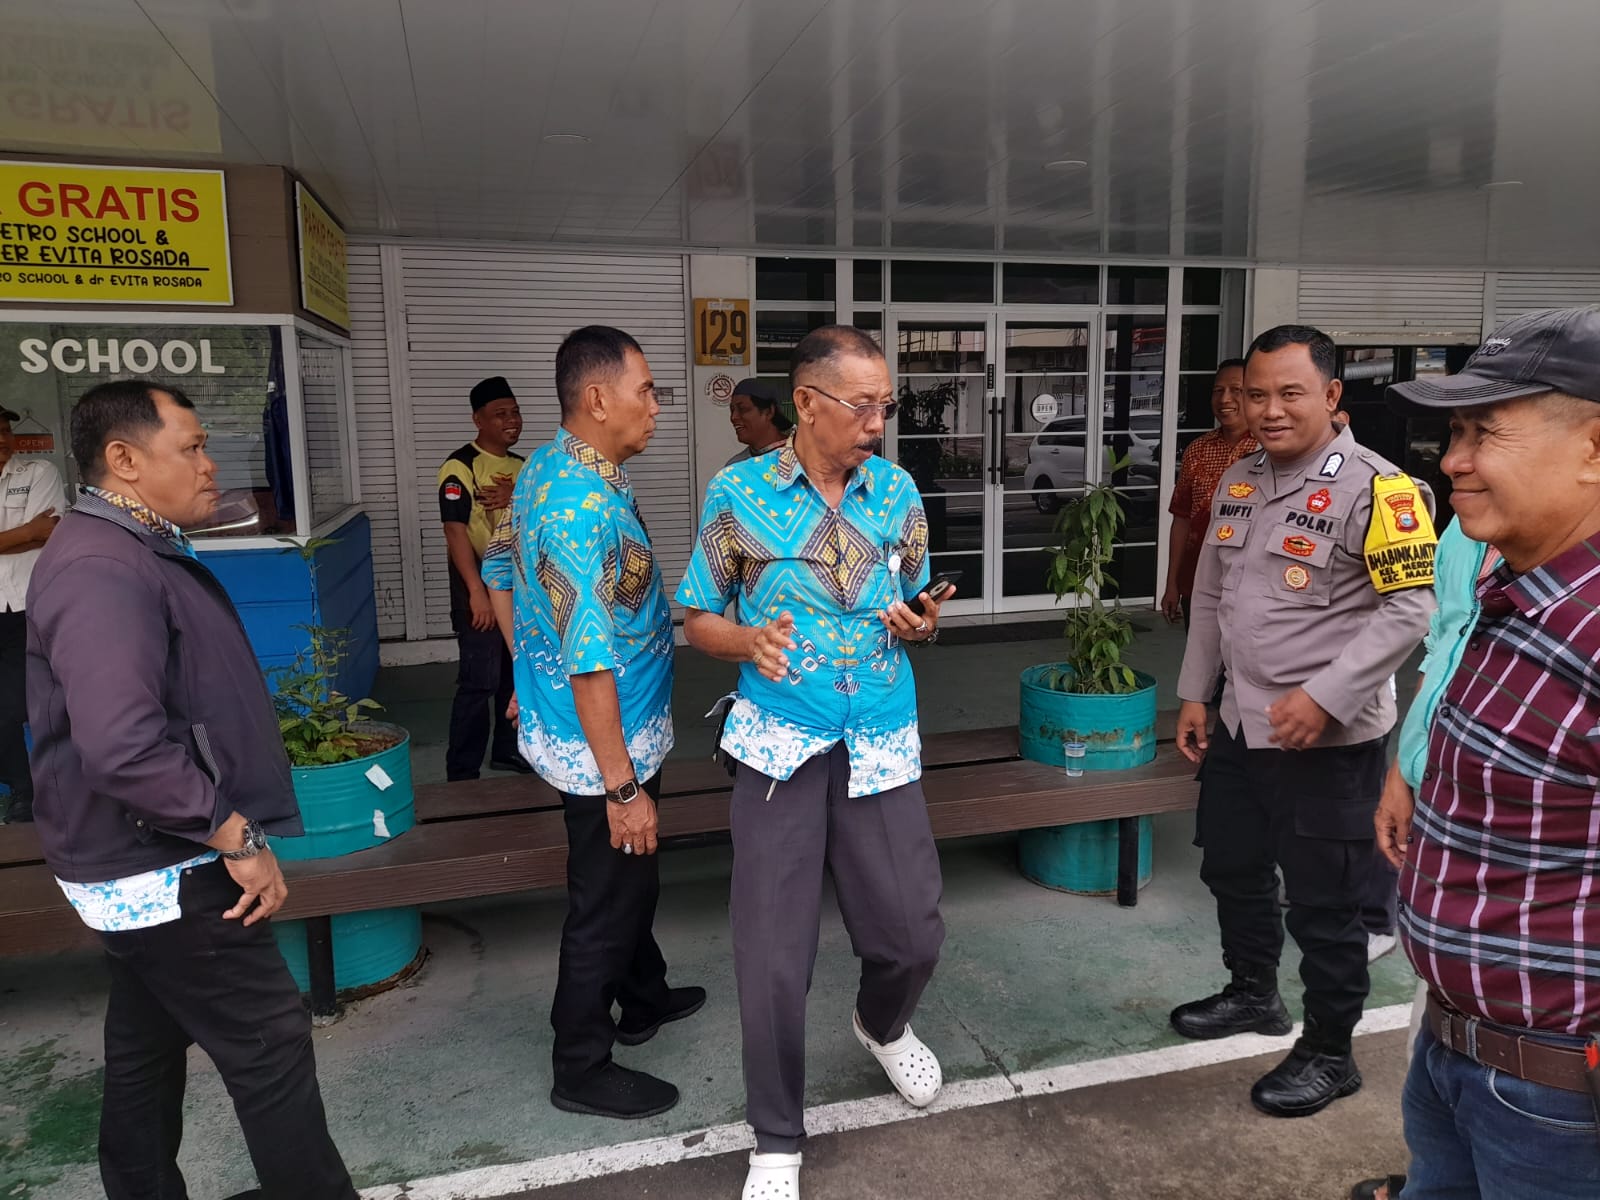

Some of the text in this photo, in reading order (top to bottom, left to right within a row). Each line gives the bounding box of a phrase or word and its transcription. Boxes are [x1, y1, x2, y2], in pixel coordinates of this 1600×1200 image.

[18, 181, 200, 223] GRATIS
[67, 226, 147, 244] SCHOOL
[156, 230, 169, 245] &
[1, 244, 190, 267] ER EVITA ROSADA
[18, 272, 69, 285] SCHOOL
[75, 274, 84, 285] &
[89, 274, 105, 285] dr
[110, 275, 149, 286] EVITA
[153, 276, 203, 288] ROSADA
[701, 309, 747, 355] 129
[19, 338, 225, 374] SCHOOL
[1285, 511, 1334, 535] POLRI
[1379, 567, 1399, 577] KEL.
[1382, 574, 1403, 585] KEC.
